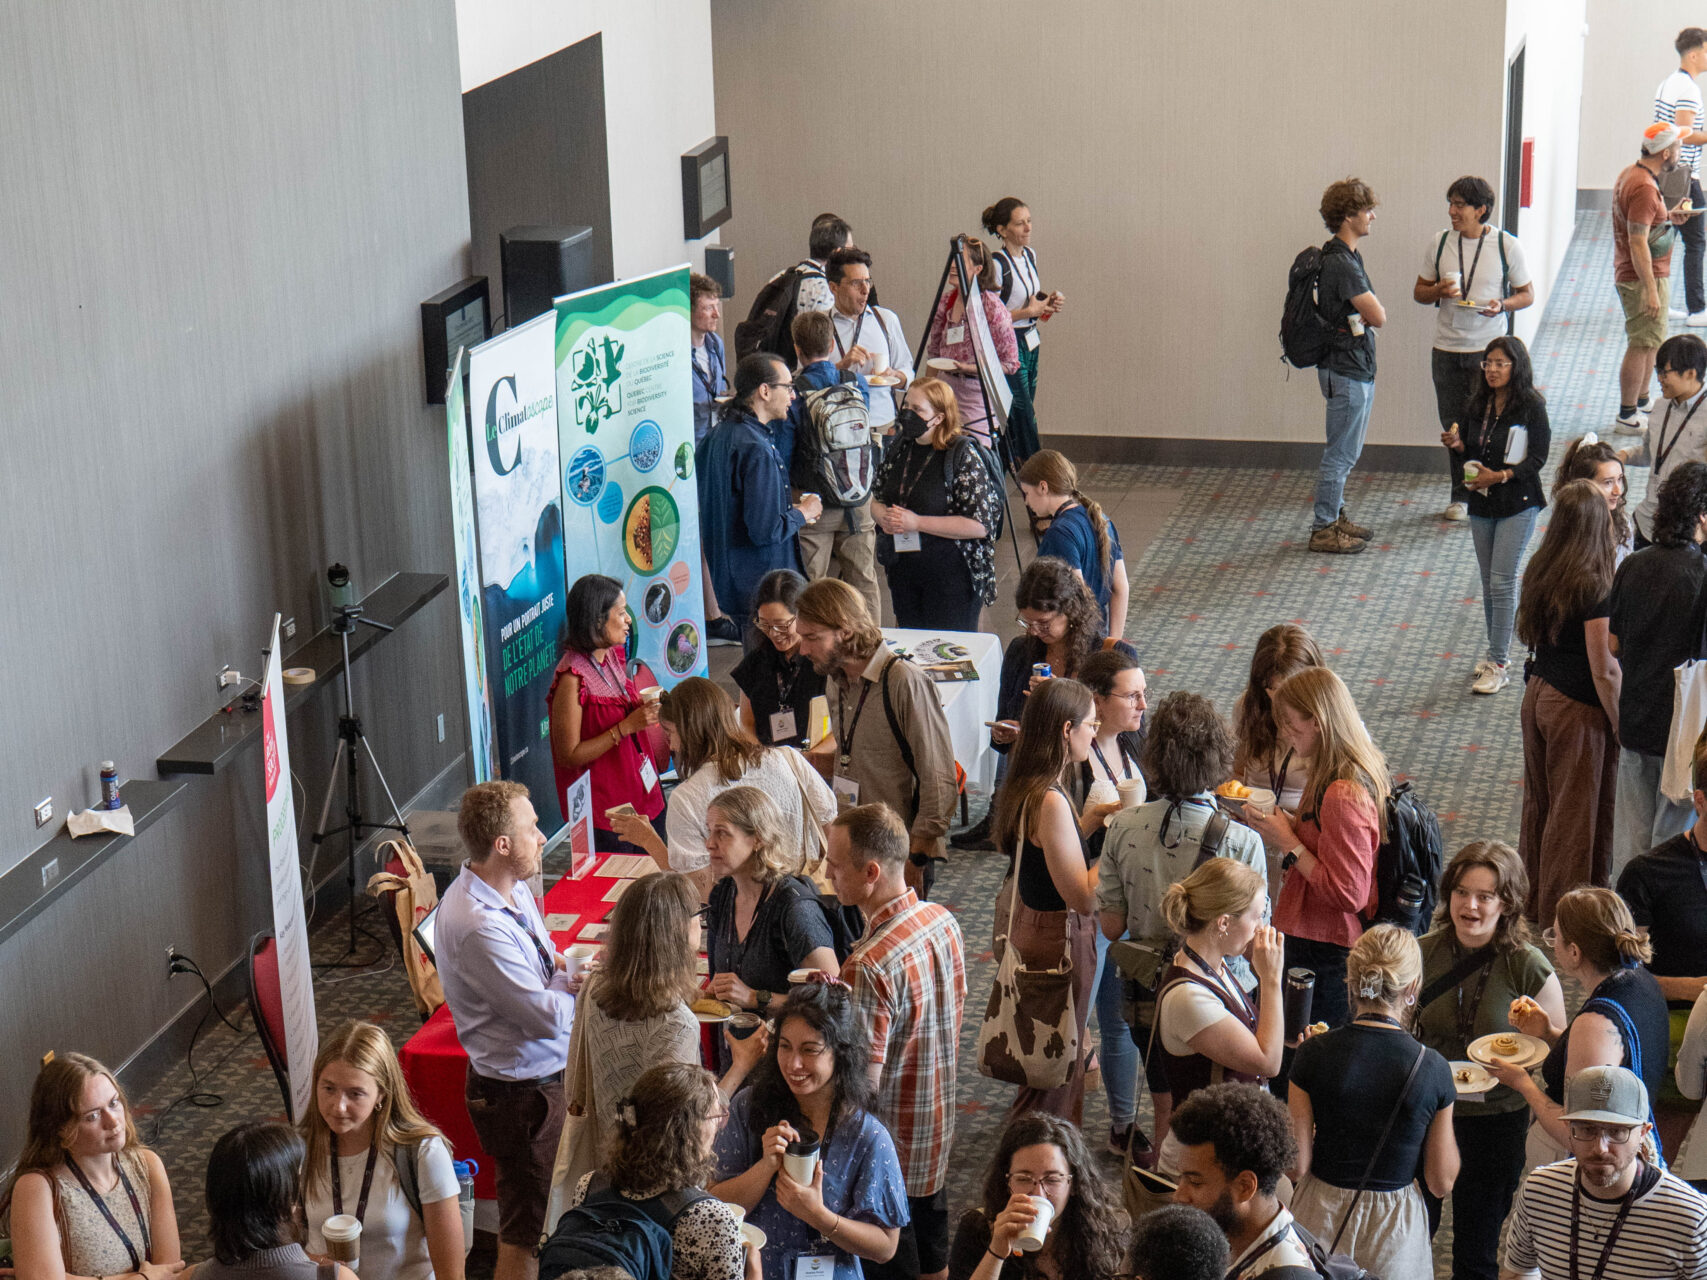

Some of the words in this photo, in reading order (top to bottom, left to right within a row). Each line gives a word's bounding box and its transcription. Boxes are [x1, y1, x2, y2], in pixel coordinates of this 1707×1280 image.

[656, 350, 675, 360] SCIENCE
[637, 391, 668, 405] BIODIVERSITY
[627, 405, 646, 416] SCIENCE
[486, 423, 497, 442] Le
[500, 622, 513, 642] POUR
[512, 617, 521, 634] UN
[521, 601, 541, 629] PORTRAIT
[541, 592, 554, 614] JUSTE
[502, 645, 512, 671] DE
[534, 621, 544, 647] DE
[505, 663, 528, 699] NOTRE
